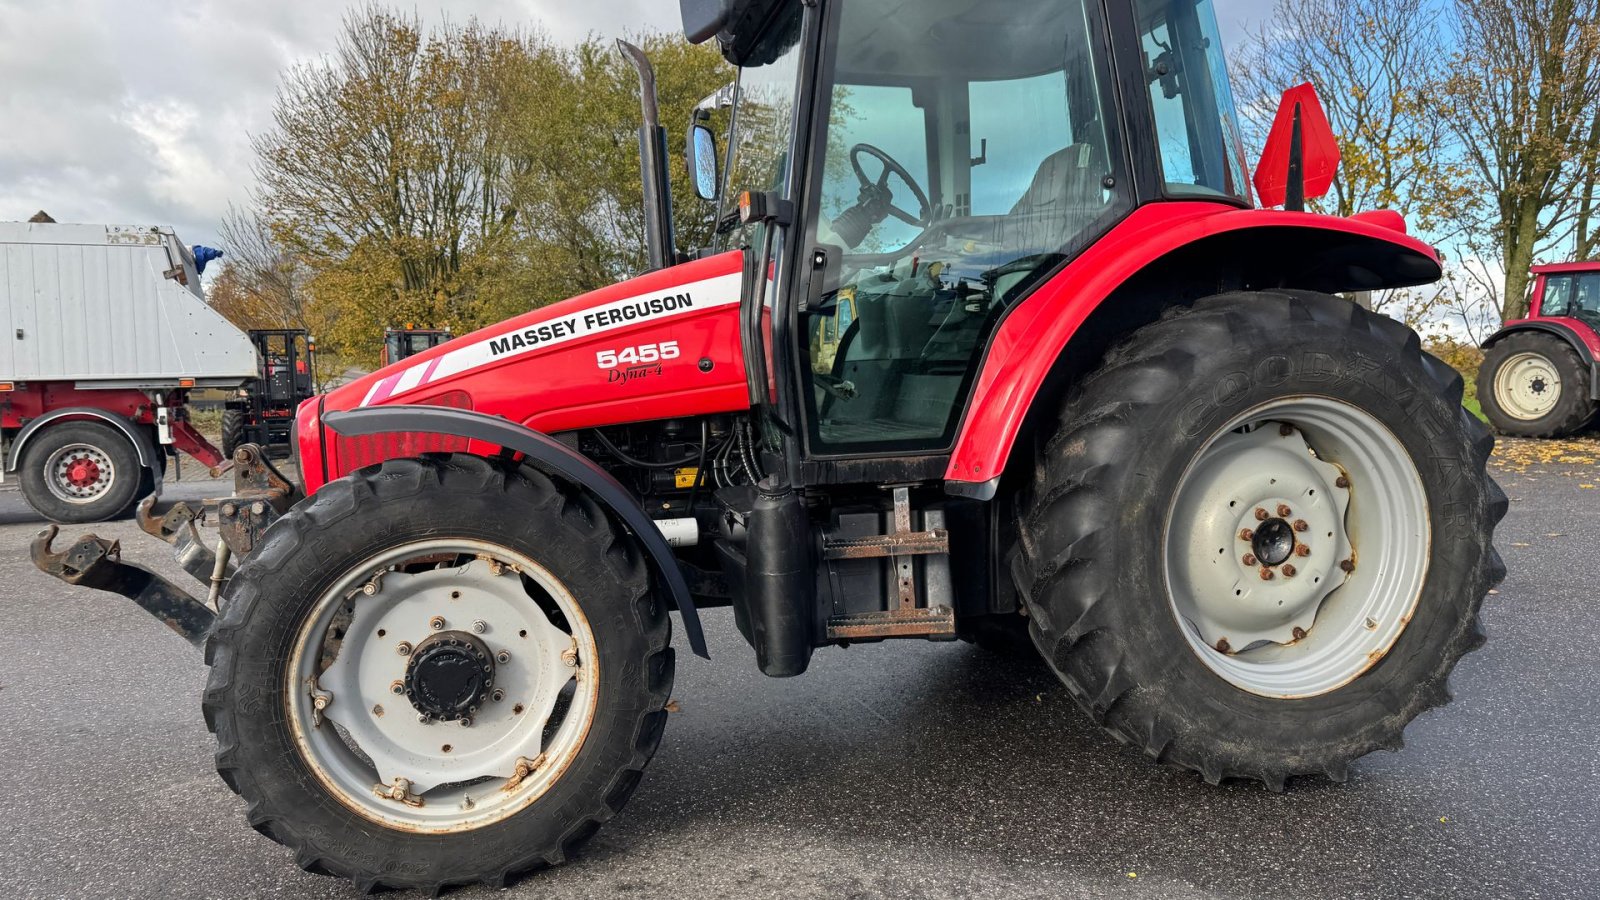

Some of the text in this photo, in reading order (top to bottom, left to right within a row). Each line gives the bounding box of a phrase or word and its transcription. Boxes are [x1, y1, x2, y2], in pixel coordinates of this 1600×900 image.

[489, 292, 693, 356] MASSEY FERGUSON
[596, 340, 680, 369] 5455
[607, 363, 663, 386] Dyna-4
[1175, 352, 1472, 540] GOODYEAR
